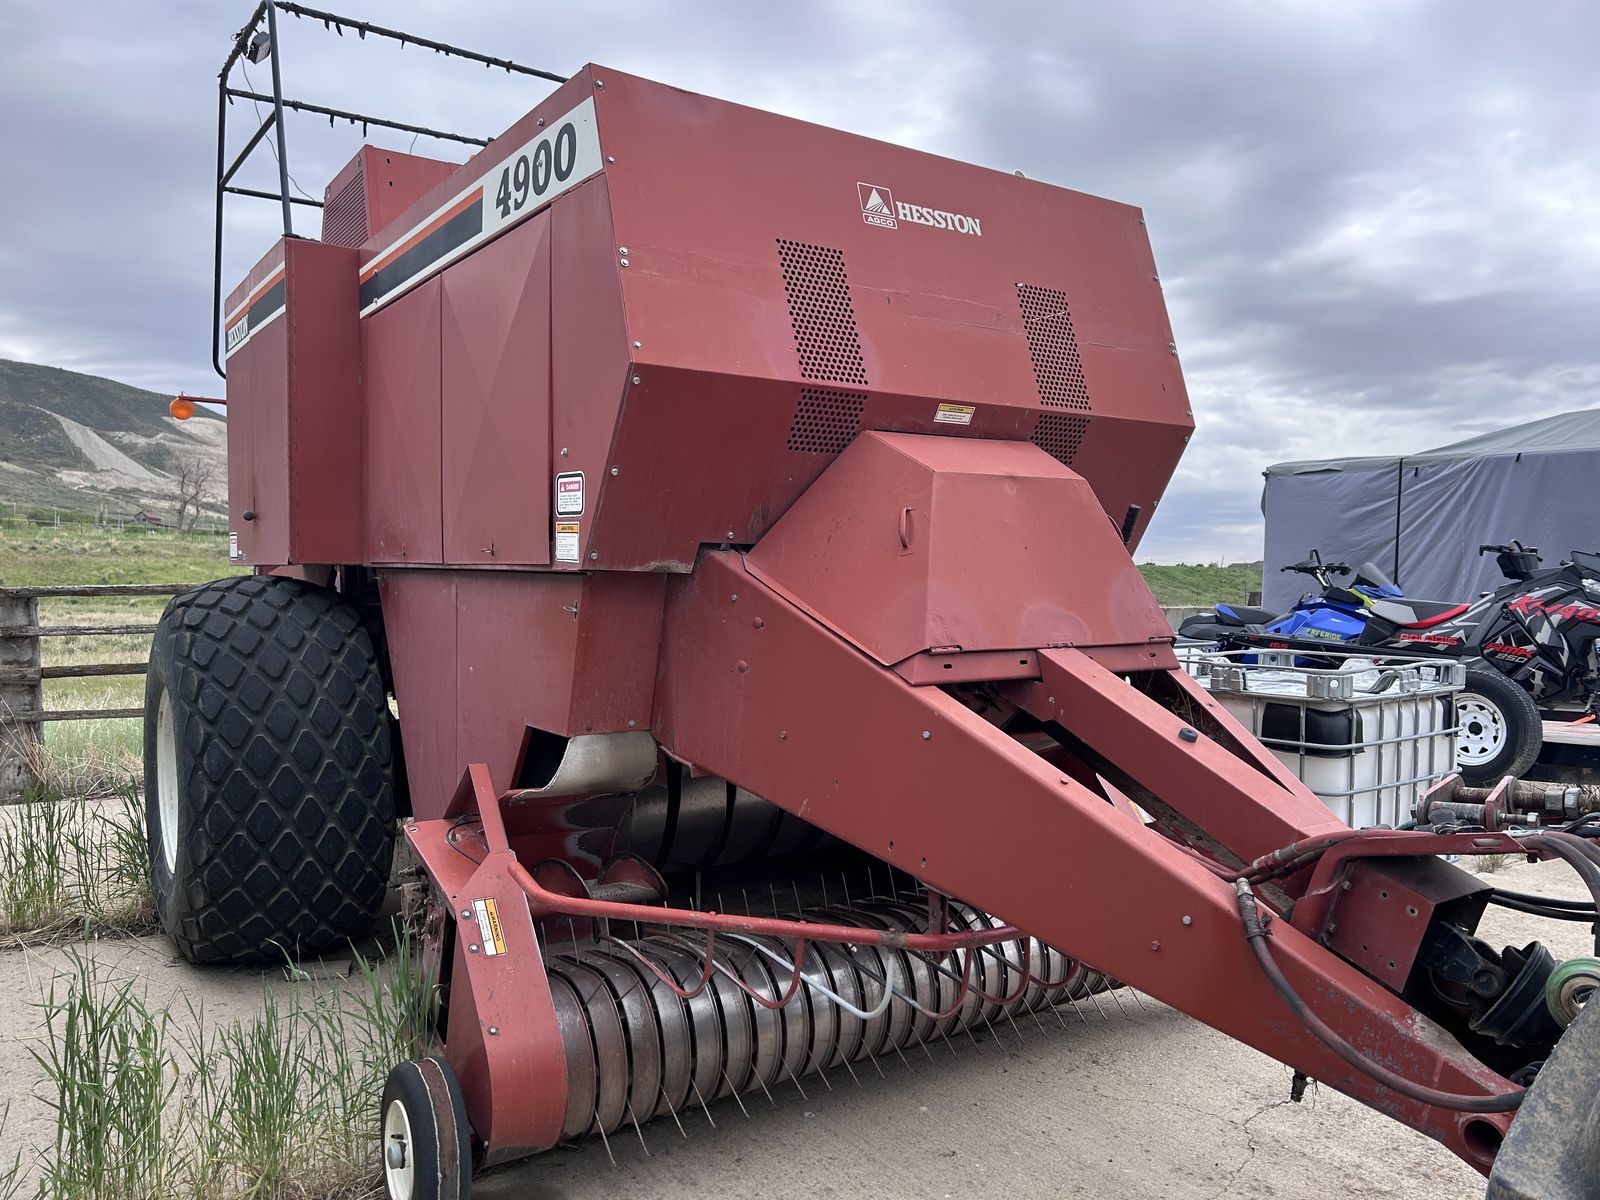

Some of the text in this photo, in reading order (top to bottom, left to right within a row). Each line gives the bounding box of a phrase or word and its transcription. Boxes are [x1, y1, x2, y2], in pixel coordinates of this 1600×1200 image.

[495, 122, 577, 219] 4900
[867, 216, 894, 227] AGCO
[896, 201, 982, 236] HESSTON
[1400, 633, 1459, 647] POLARIS
[1495, 653, 1529, 664] 850
[490, 915, 502, 942] WARNING
